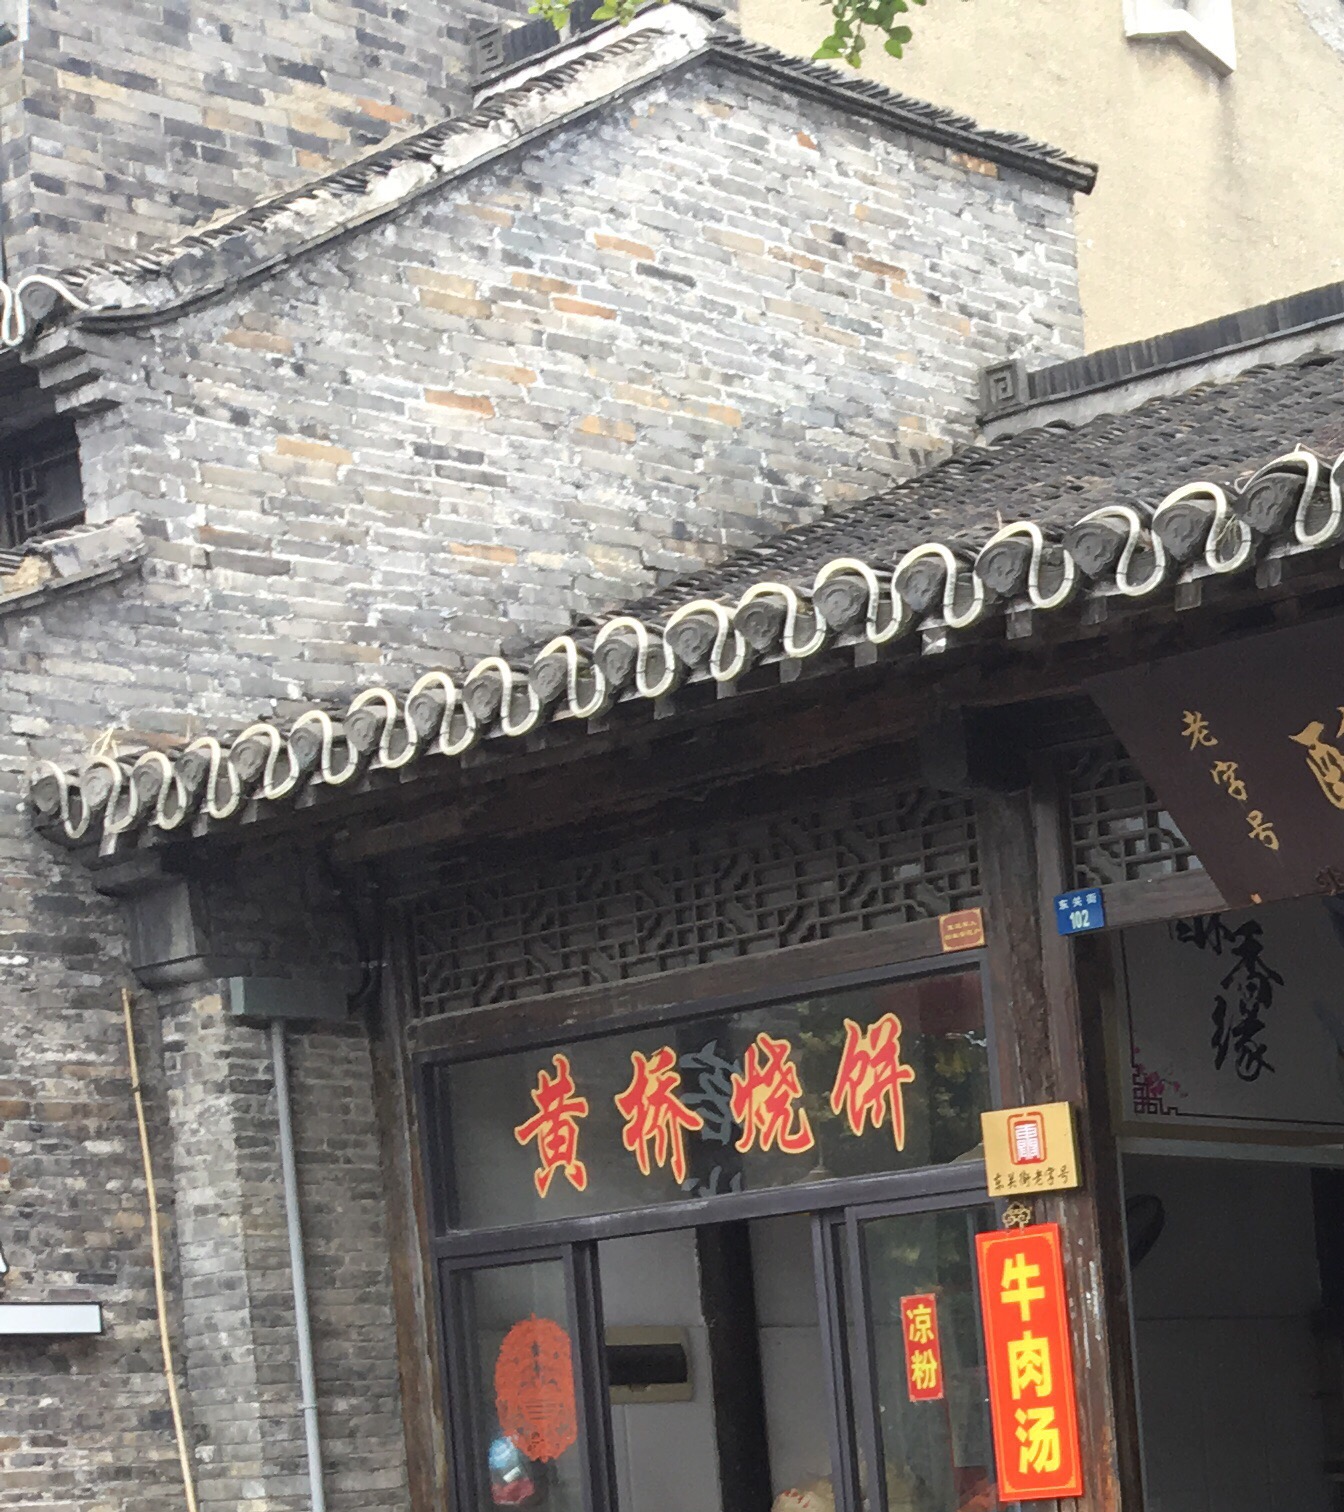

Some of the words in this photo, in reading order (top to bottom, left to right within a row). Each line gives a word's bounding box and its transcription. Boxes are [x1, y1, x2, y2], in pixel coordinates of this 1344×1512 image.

[1181, 709, 1281, 852] 老字号
[1058, 892, 1097, 910] 东关街
[1069, 909, 1091, 929] 102
[514, 1012, 915, 1198] 黄桥烧饼
[993, 1165, 1069, 1191] 东关街老字号
[905, 1302, 939, 1391] 凉粉
[1000, 1252, 1062, 1475] 牛肉汤
